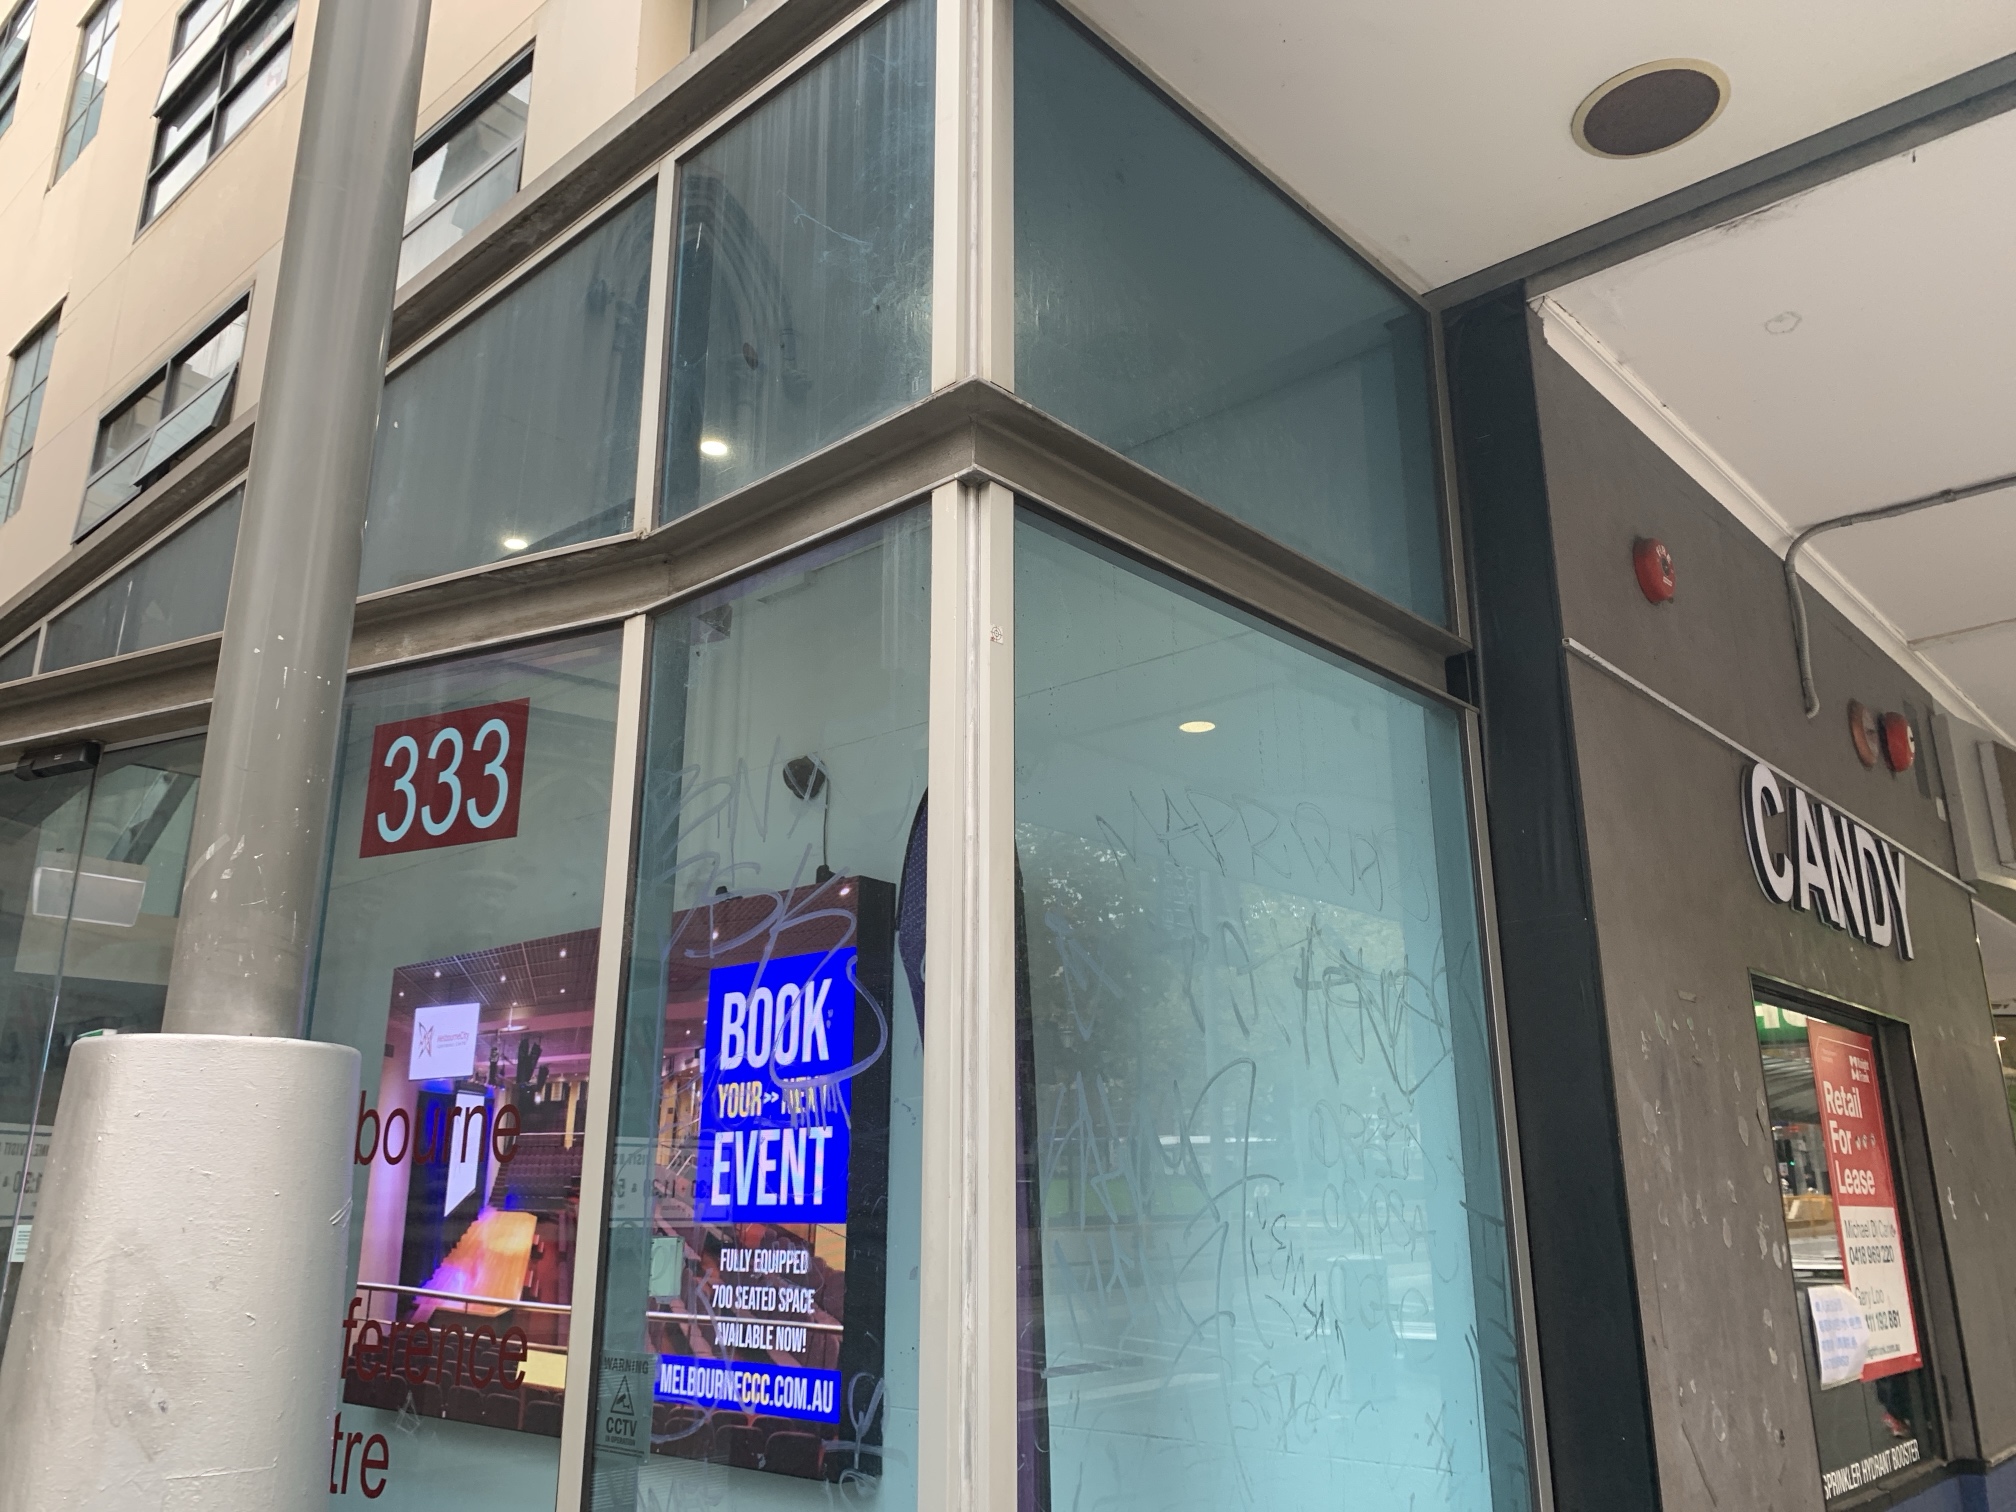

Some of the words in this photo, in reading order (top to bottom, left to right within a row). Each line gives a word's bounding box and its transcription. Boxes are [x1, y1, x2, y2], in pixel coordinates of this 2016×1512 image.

[377, 718, 510, 843] 333
[1740, 762, 1914, 961] CANDY
[719, 978, 833, 1071] BOOK
[718, 1081, 763, 1119] YOUR
[1823, 1080, 1863, 1119] Retail
[354, 1090, 521, 1165] bourne
[1829, 1120, 1852, 1155] For
[711, 1126, 833, 1206] EVENT
[1835, 1161, 1876, 1196] Lease
[1844, 1219, 1870, 1238] Michael
[720, 1248, 752, 1272] FULLY
[754, 1249, 809, 1275] EQUIPPED
[1849, 1245, 1867, 1265] 0418
[1881, 1245, 1895, 1263] 220
[712, 1284, 732, 1308] 700
[734, 1285, 776, 1311] SEATED
[778, 1287, 816, 1314] SPACE
[715, 1322, 774, 1350] AVAILABLE
[775, 1327, 807, 1353] NOW!
[604, 1357, 649, 1374] WARNING
[659, 1364, 834, 1414] MELBOURNECCC.COM.AU
[606, 1417, 637, 1437] CCTV
[611, 1436, 636, 1446] OPERATION
[1822, 1462, 1863, 1501] SPRINKLER
[1861, 1450, 1892, 1484] HYDRANT
[1892, 1439, 1920, 1471] BOOSTER
